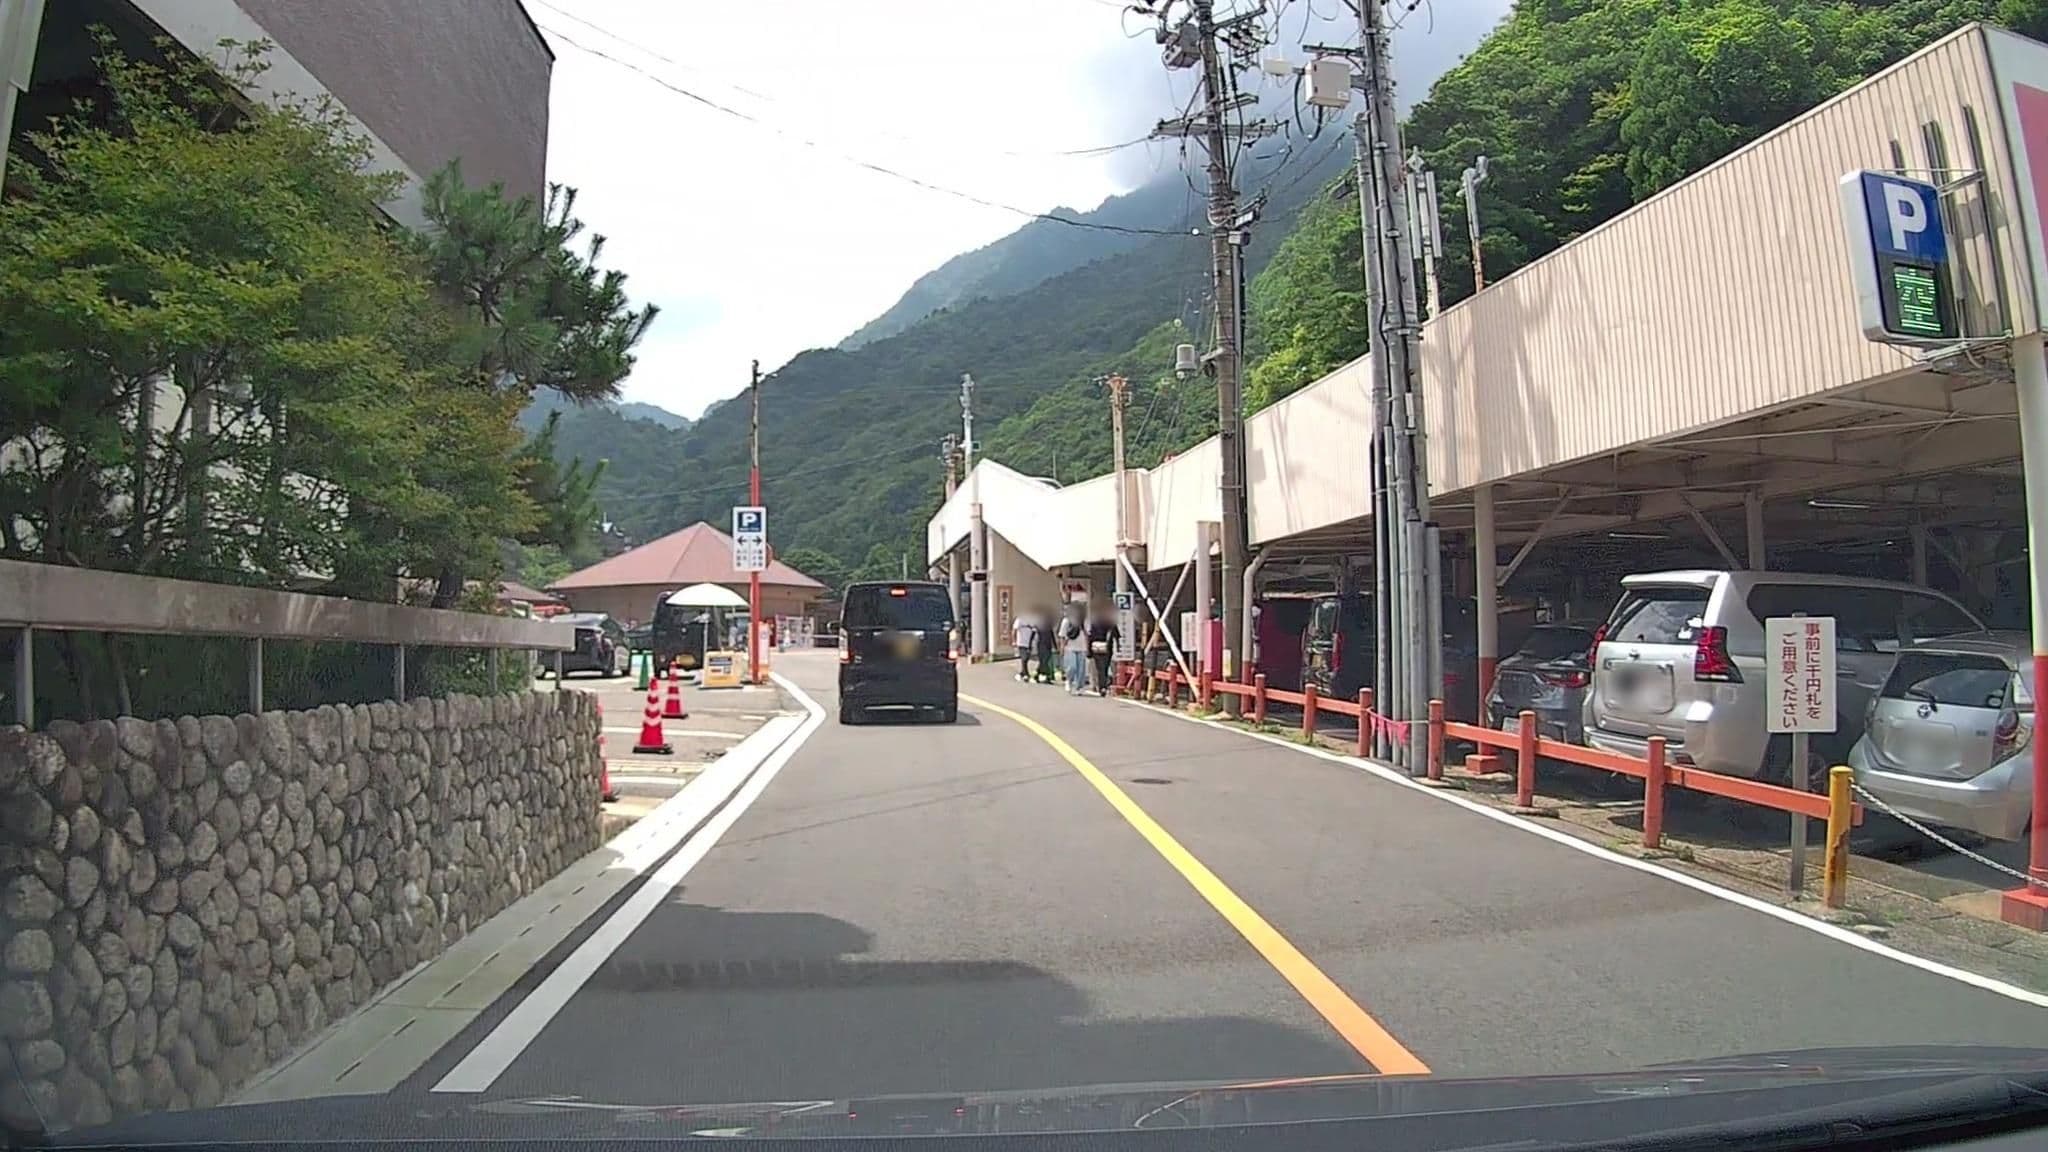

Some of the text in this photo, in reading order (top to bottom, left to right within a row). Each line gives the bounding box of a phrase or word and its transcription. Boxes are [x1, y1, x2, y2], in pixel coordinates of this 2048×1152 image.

[1883, 182, 1927, 250] P
[1894, 268, 1941, 331] 空
[742, 513, 757, 527] P
[1117, 596, 1127, 608] P
[1782, 632, 1799, 728] ご用意ください
[1805, 623, 1821, 719] 事前に千円札を
